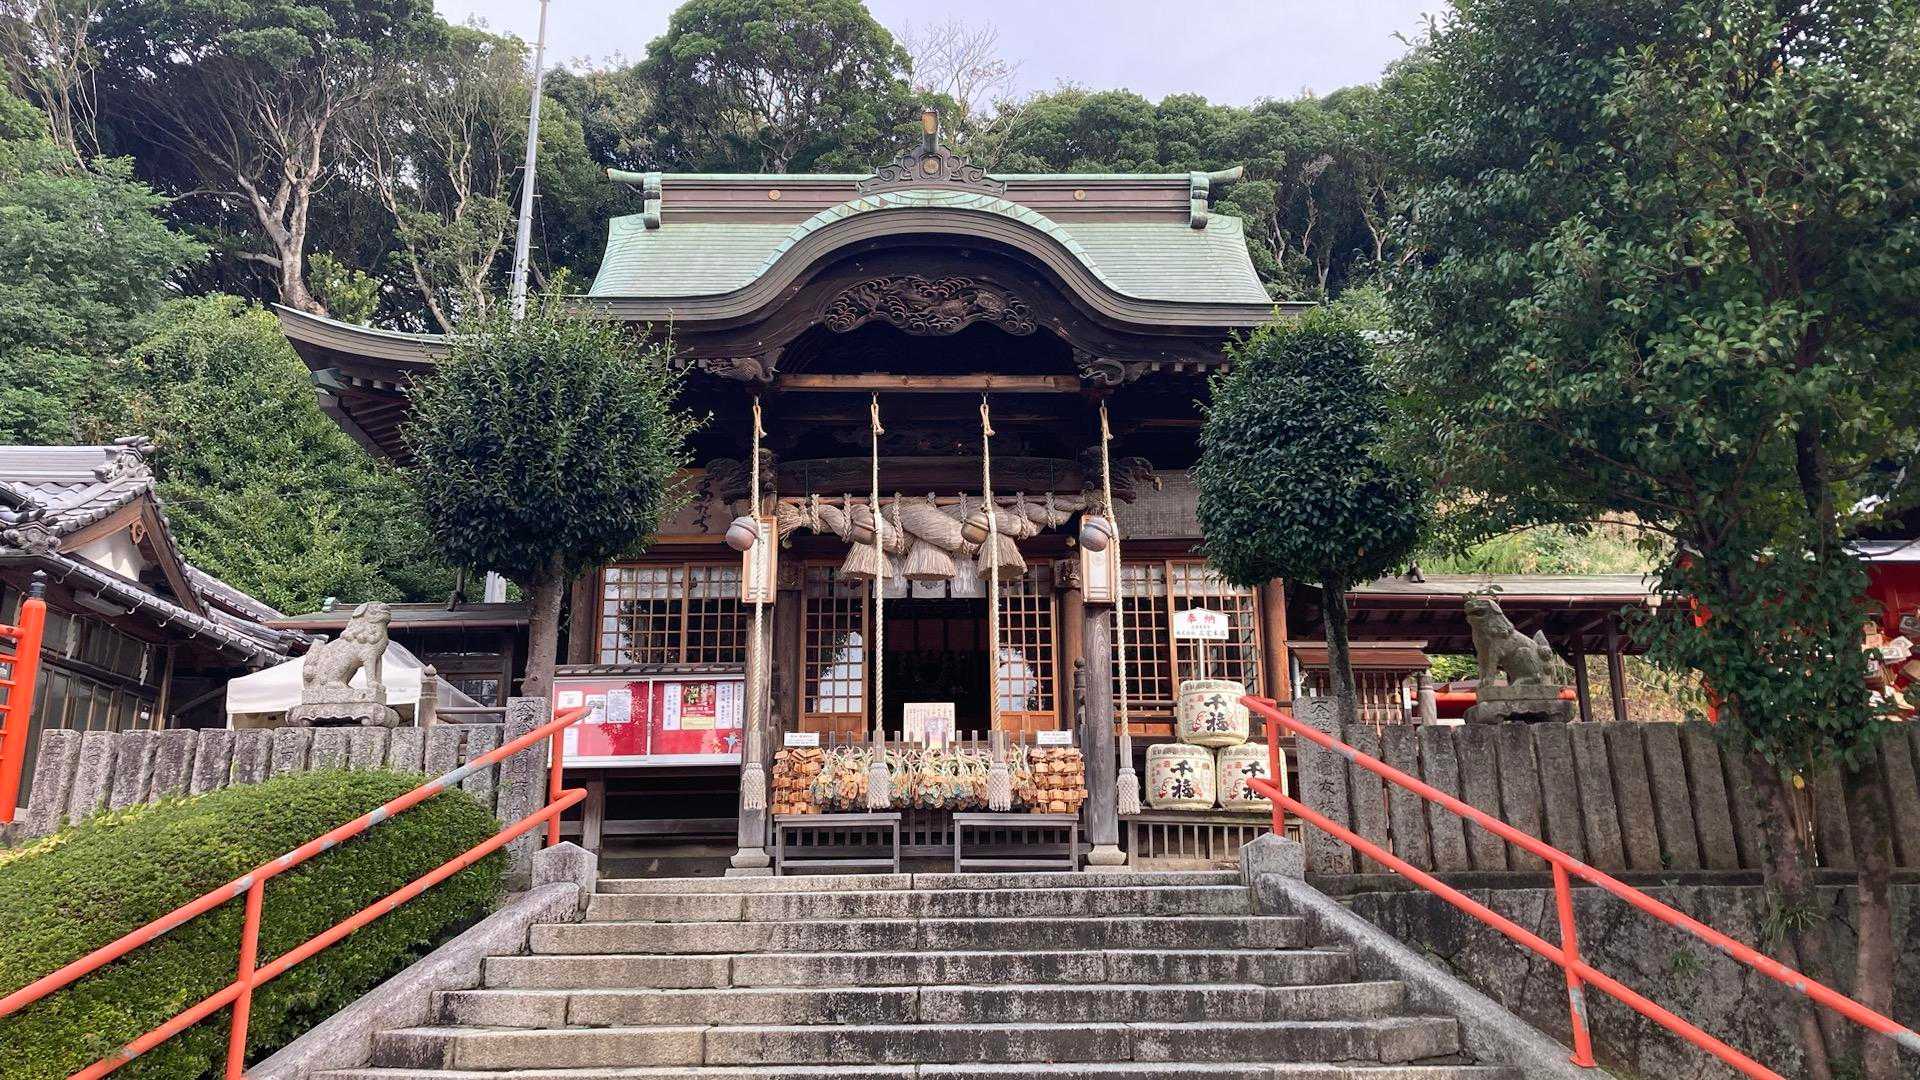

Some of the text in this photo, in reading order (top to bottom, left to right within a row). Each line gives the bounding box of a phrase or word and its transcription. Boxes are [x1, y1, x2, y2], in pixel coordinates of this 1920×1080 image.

[1187, 613, 1216, 625] 奉納
[1203, 694, 1229, 732] 千福
[1170, 760, 1195, 800] 千福
